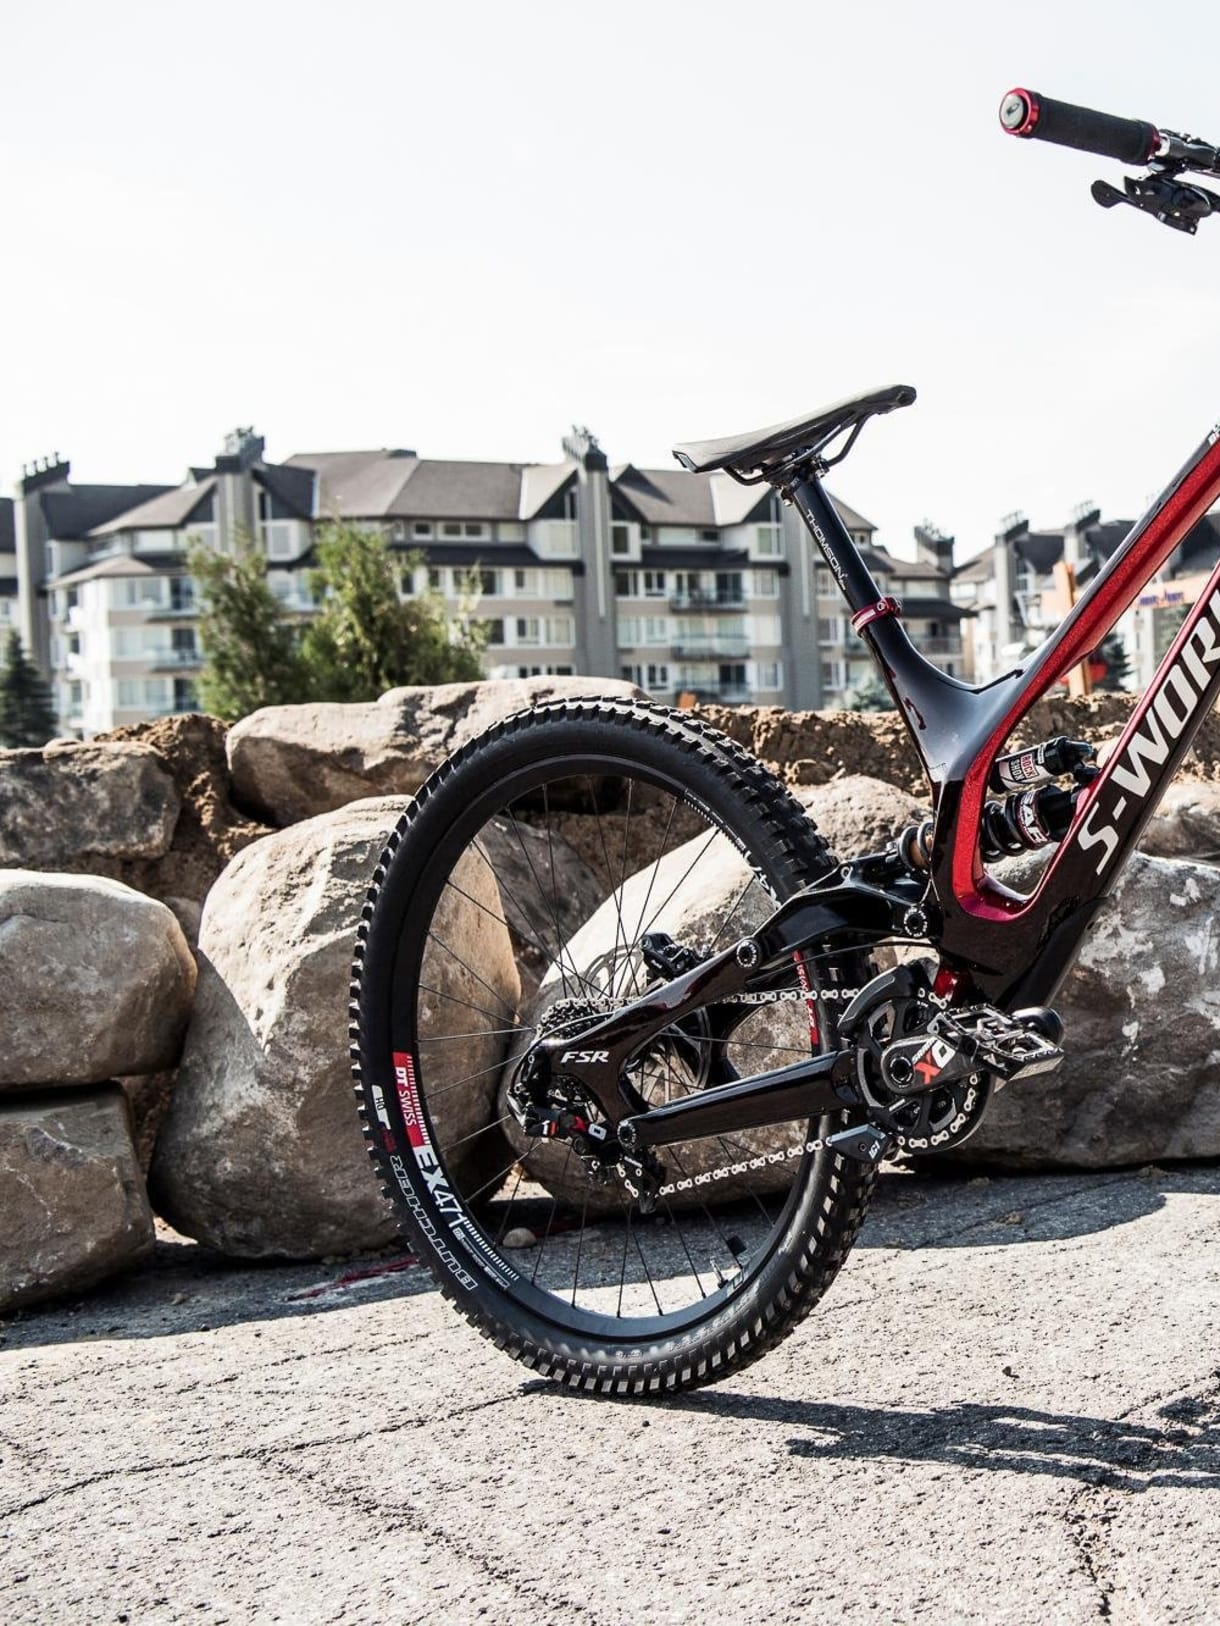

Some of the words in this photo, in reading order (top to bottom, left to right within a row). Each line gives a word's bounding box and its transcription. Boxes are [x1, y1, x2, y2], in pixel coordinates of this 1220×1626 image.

[806, 508, 846, 580] THOMSON
[1021, 754, 1038, 778] ROCK
[560, 1050, 610, 1063] FSR
[395, 1066, 408, 1087] DT
[399, 1090, 417, 1127] SWISS
[389, 1154, 479, 1291] BUTCHER
